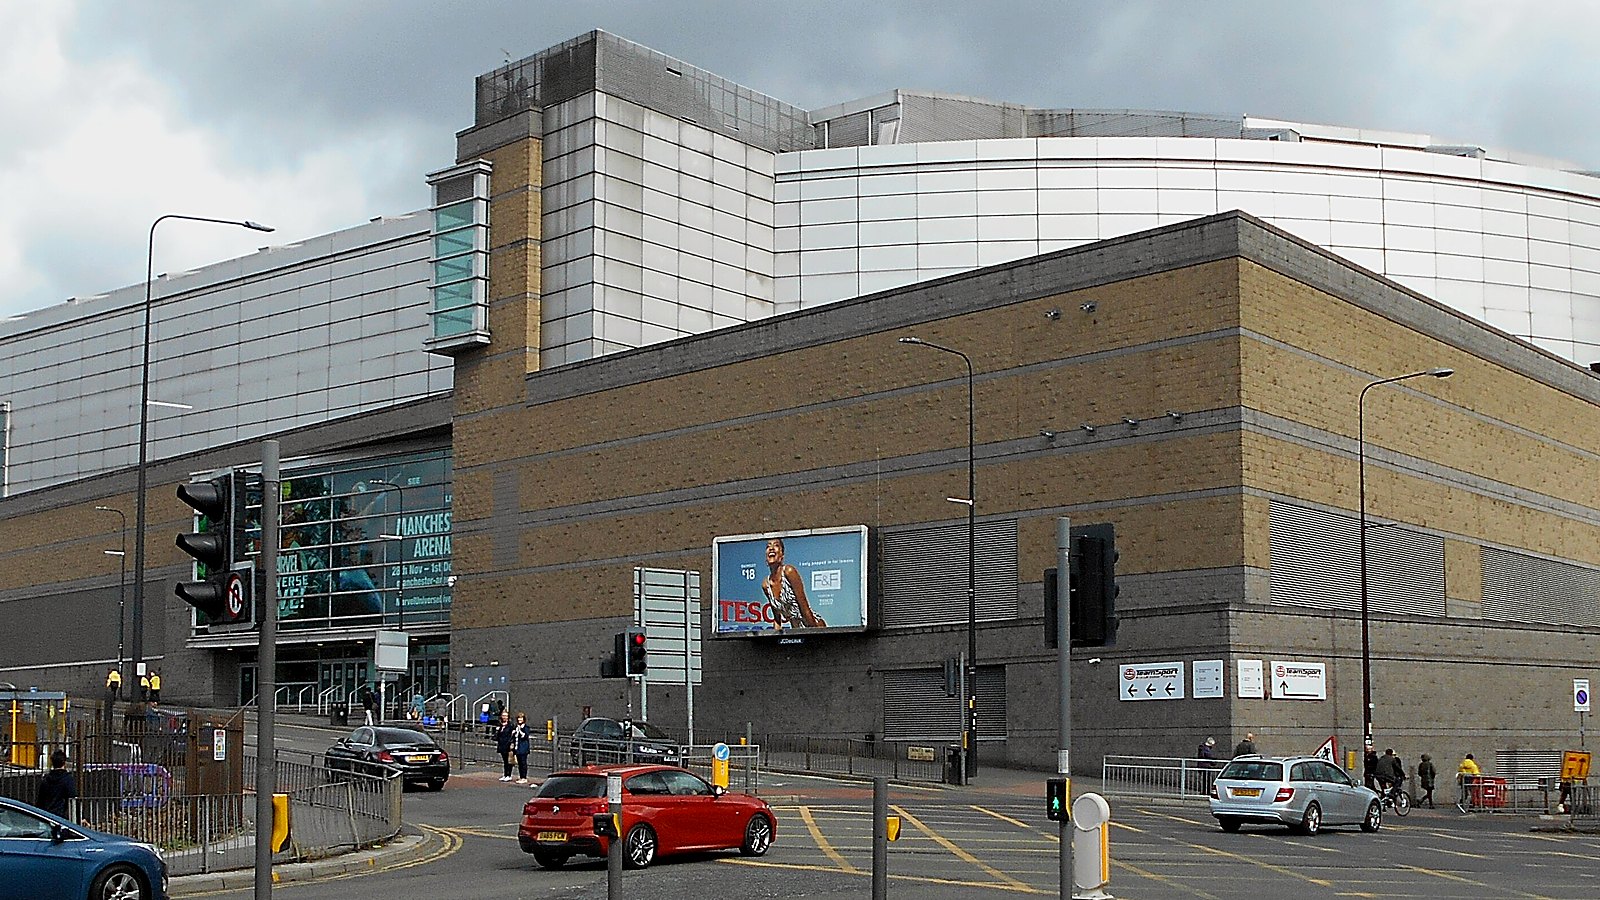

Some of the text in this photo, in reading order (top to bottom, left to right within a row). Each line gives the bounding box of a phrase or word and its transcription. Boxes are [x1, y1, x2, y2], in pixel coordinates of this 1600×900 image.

[396, 512, 452, 536] MANCHES
[414, 535, 451, 558] ARENA
[741, 568, 756, 580] £18
[813, 572, 839, 588] F&F
[719, 600, 789, 625] TESC
